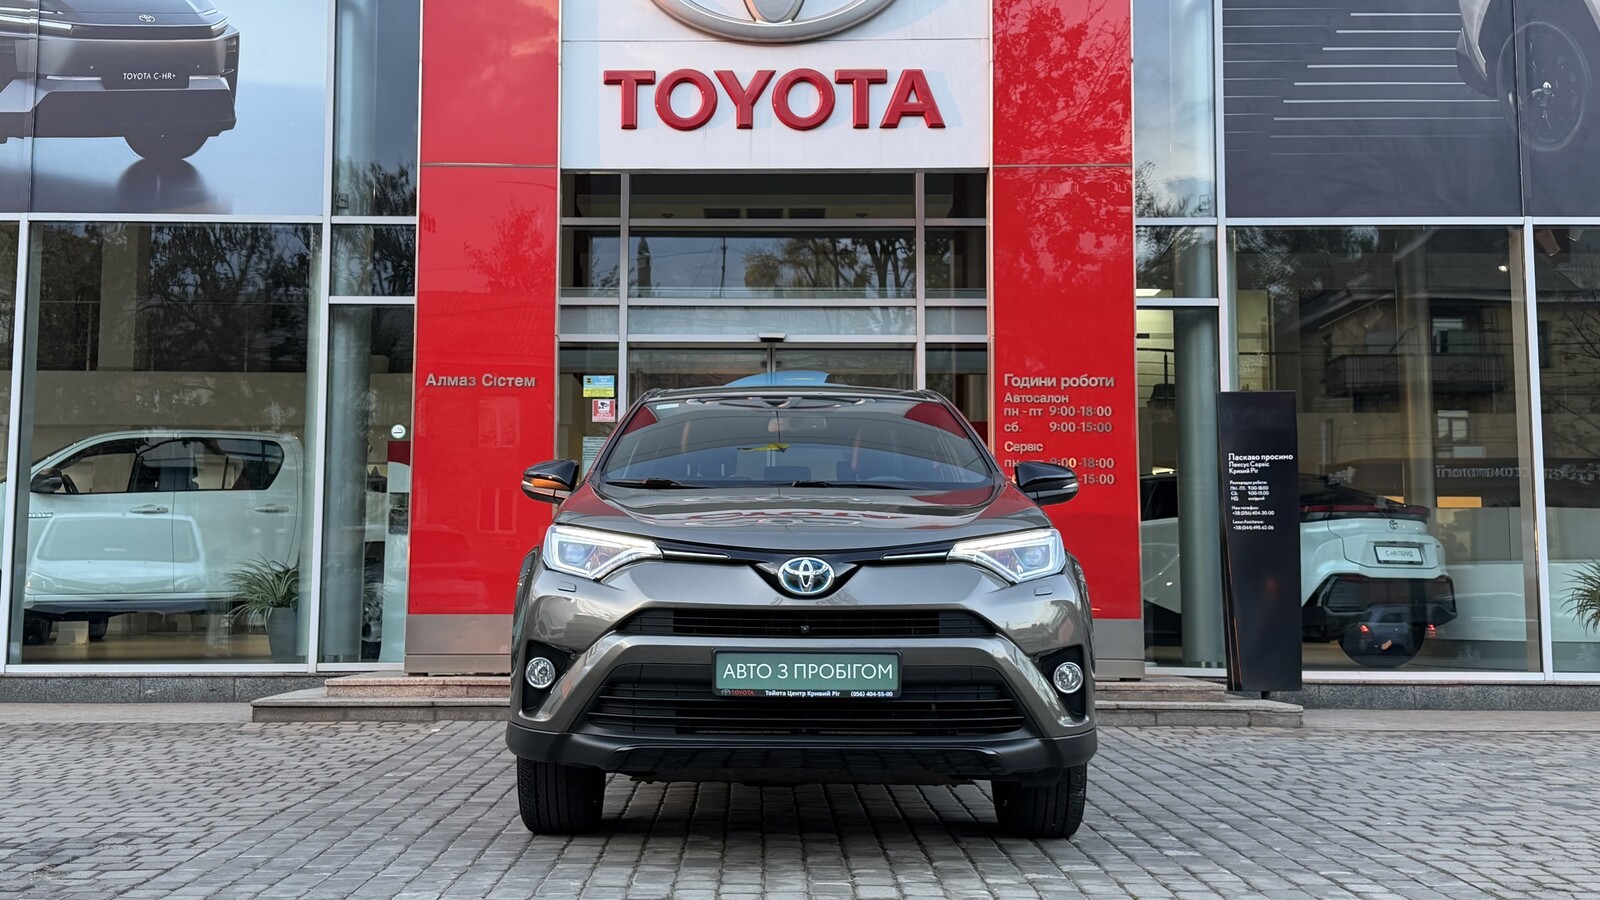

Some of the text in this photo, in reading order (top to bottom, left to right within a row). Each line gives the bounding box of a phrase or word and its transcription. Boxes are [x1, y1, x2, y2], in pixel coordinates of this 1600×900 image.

[122, 72, 177, 81] TOYOTA C-HR+
[603, 68, 946, 131] TOYOTA
[425, 373, 536, 387] Алмаз Сістем
[1004, 374, 1115, 390] Години роботи
[1004, 393, 1069, 404] Автосалон
[1004, 407, 1019, 417] пн
[1028, 408, 1043, 417] пт
[1049, 406, 1112, 417] 9:00-18:00
[1004, 422, 1112, 433] сб. 9:00-15:00
[1004, 441, 1044, 454] Сервіс
[1228, 453, 1294, 461] Ласкаво просимо
[722, 663, 893, 680] АВТО З ПРОБІГОМ
[765, 689, 787, 697] Тойота
[787, 690, 806, 698] Центр
[807, 690, 831, 698] Кривий
[850, 690, 865, 698] (056)
